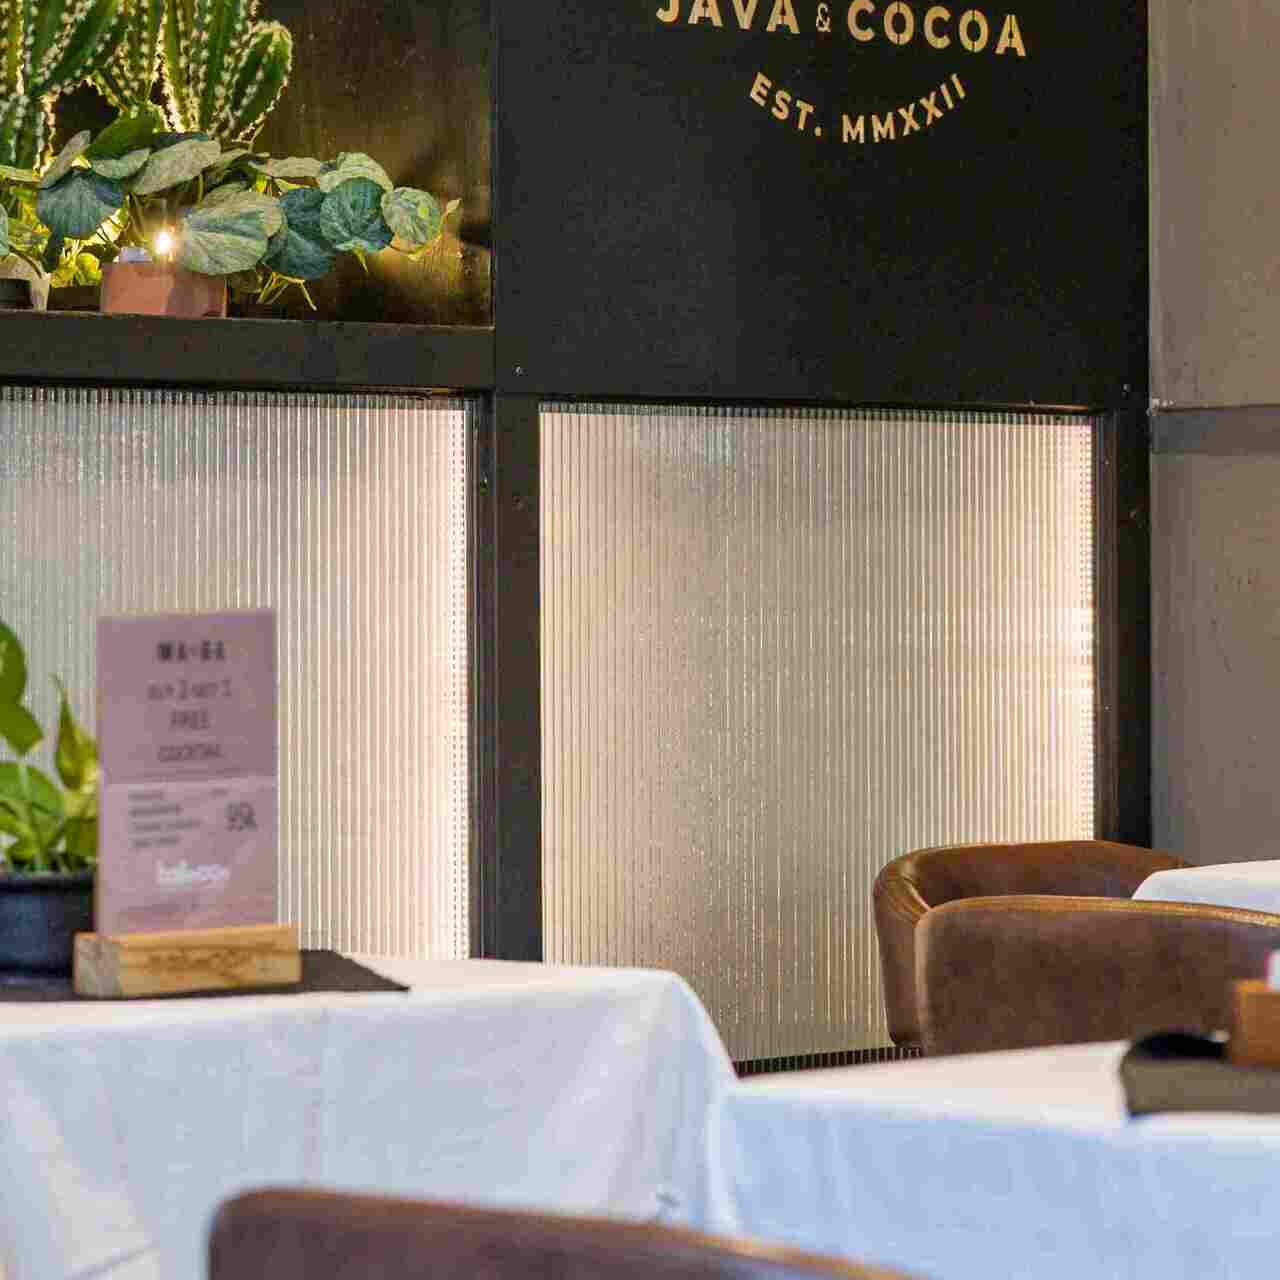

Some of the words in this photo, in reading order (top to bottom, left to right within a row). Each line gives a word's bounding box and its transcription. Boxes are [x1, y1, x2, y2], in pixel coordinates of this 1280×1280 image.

[816, 3, 831, 32] &
[750, 72, 822, 136] EST.
[843, 74, 965, 143] MMXXII
